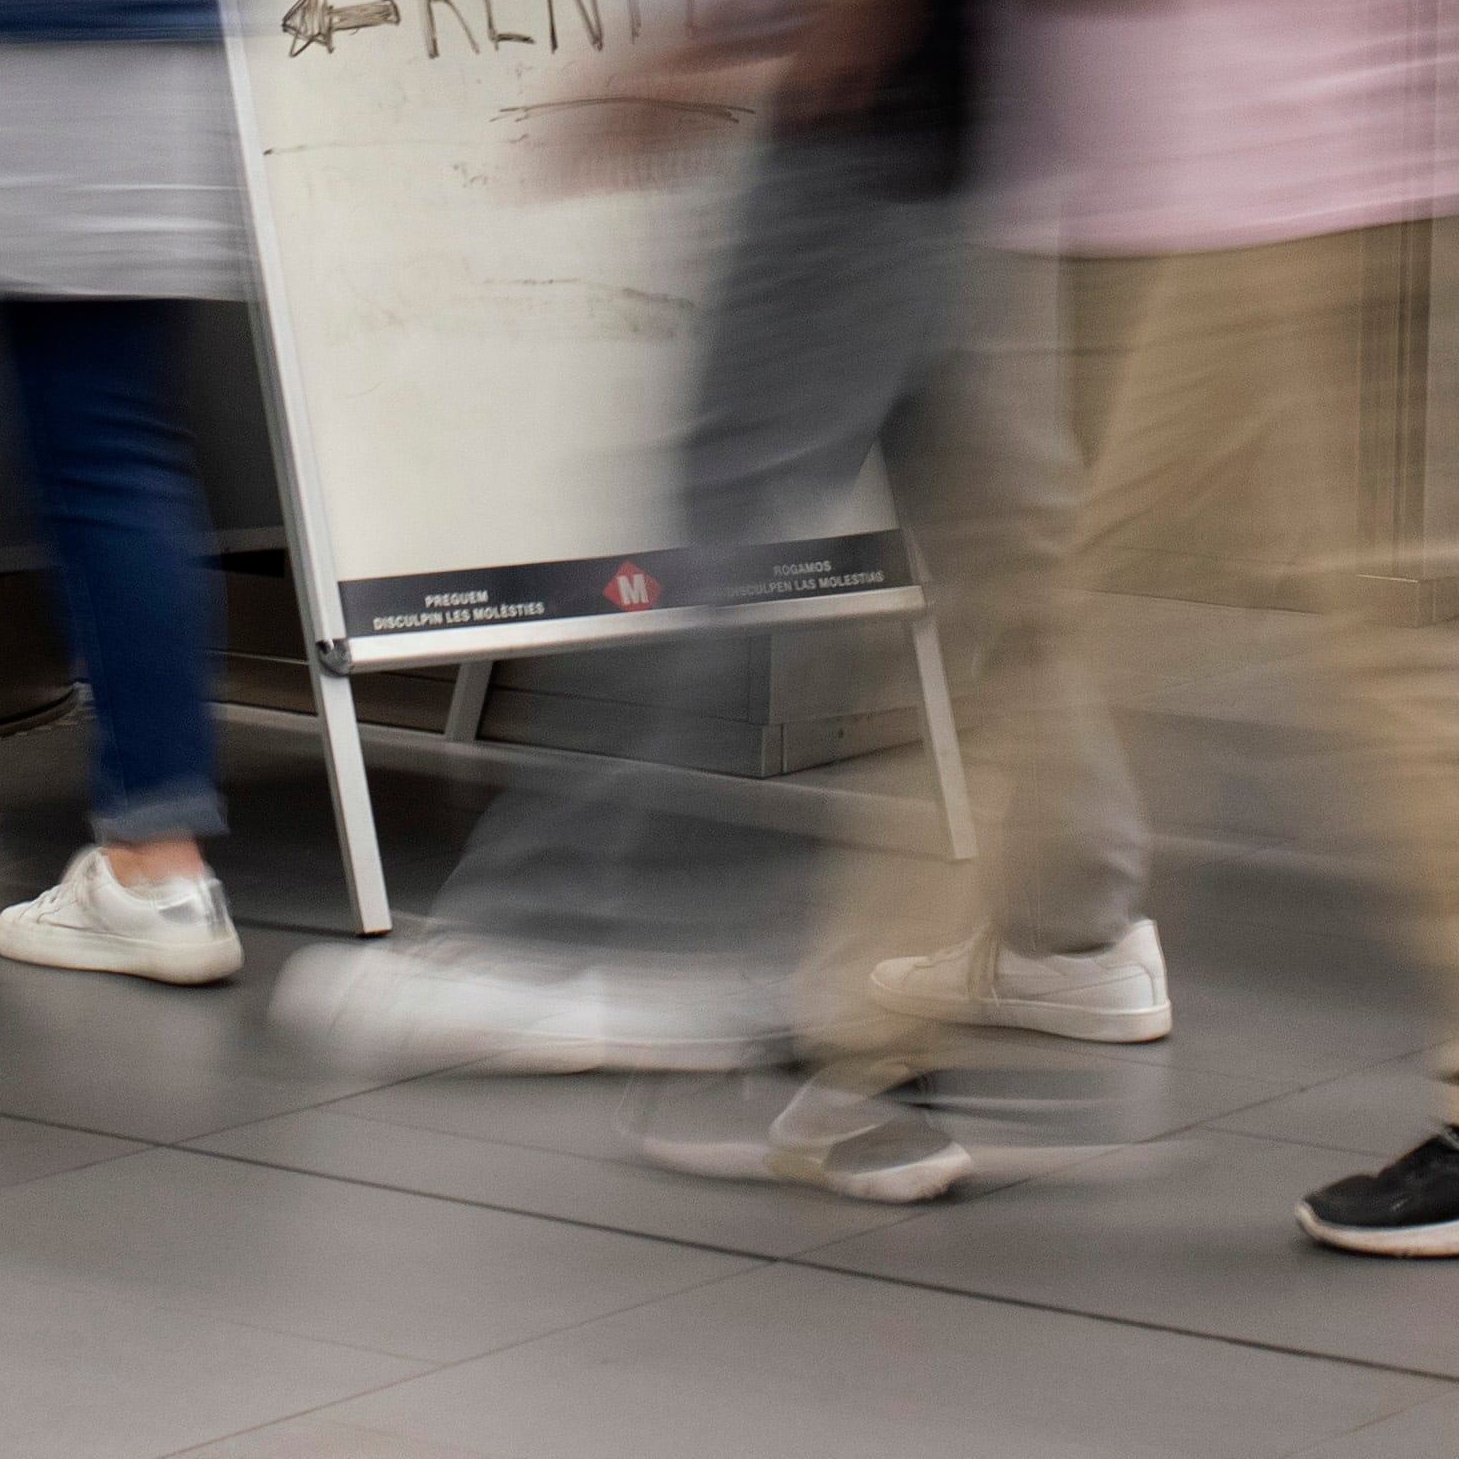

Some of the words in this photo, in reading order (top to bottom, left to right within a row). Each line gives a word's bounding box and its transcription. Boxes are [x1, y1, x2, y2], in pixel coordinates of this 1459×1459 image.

[772, 560, 833, 577] ROGAMOS
[616, 573, 650, 607] M
[793, 577, 817, 591] LAS
[424, 589, 489, 609] PREGUEM
[372, 611, 443, 631] DISCULPIN
[445, 608, 472, 624] LES
